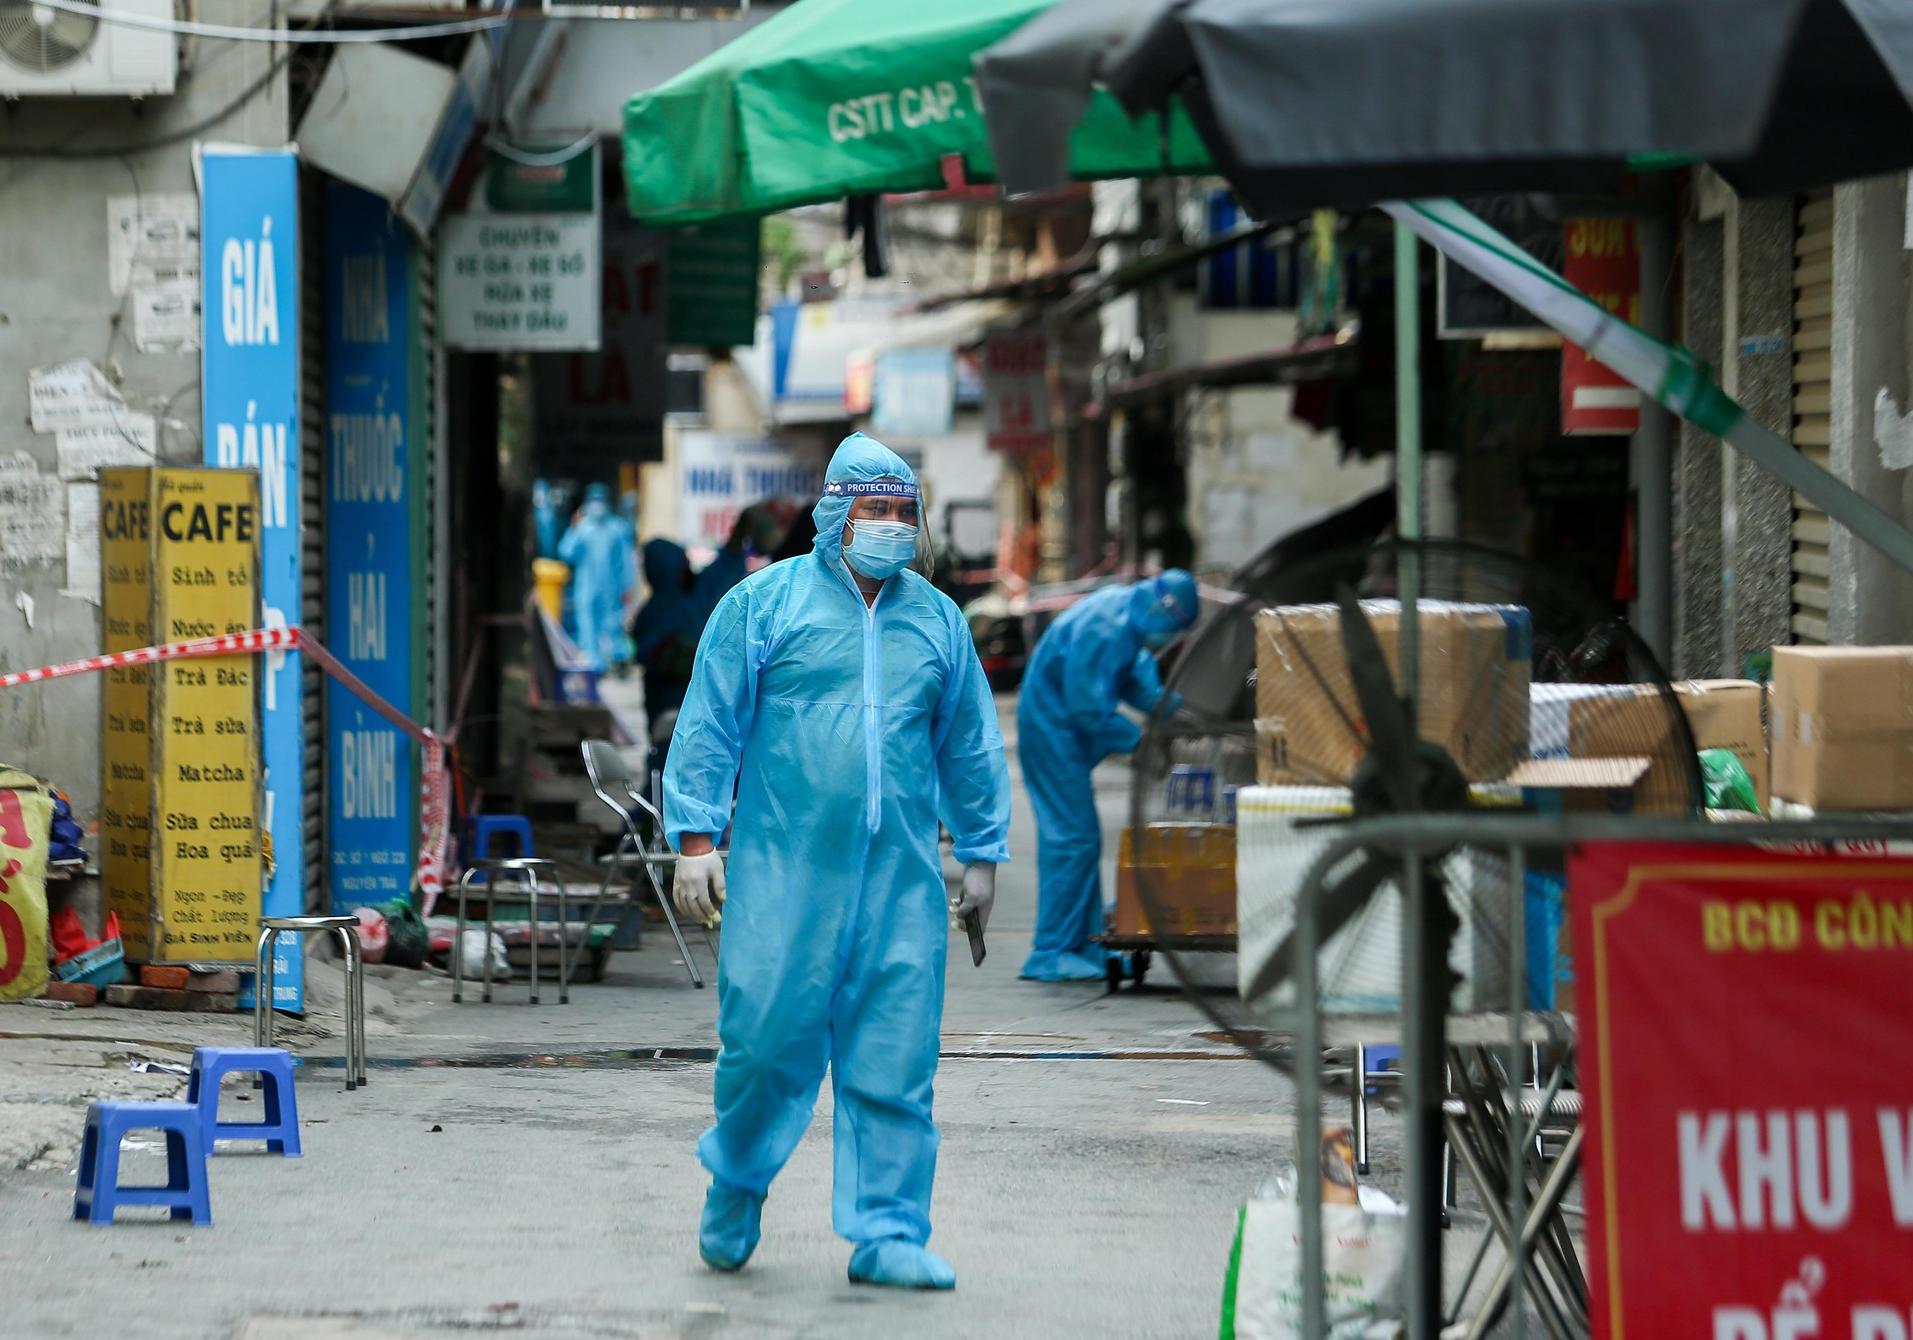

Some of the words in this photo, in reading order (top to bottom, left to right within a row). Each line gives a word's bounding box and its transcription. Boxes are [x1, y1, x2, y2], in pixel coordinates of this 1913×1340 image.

[828, 91, 895, 143] CSTT
[899, 80, 966, 128] CAP.
[221, 215, 280, 347] GIÁ
[331, 379, 404, 502] THUỐC
[847, 483, 902, 493] PROTECTION
[103, 499, 150, 542] CAFE
[161, 502, 254, 543] CAFE
[171, 565, 217, 587] Sinh
[227, 561, 250, 588] tố
[347, 532, 387, 661] HẢI
[171, 618, 216, 638] Nước
[174, 667, 208, 687] Trà
[171, 716, 205, 736] Trà
[178, 763, 246, 783] Matcha
[341, 710, 397, 819] BÌNH
[166, 812, 200, 832] Sữa
[209, 811, 253, 832] chua
[175, 842, 210, 860] Hoa
[220, 839, 255, 863] quả
[174, 889, 206, 907] Ngon
[171, 905, 204, 924] Chất
[1703, 900, 1799, 950] BCĐ
[164, 931, 185, 945] GIÁ
[189, 932, 221, 945] SINH
[223, 930, 253, 946] VIÊN
[1677, 1110, 1853, 1232] KHU
